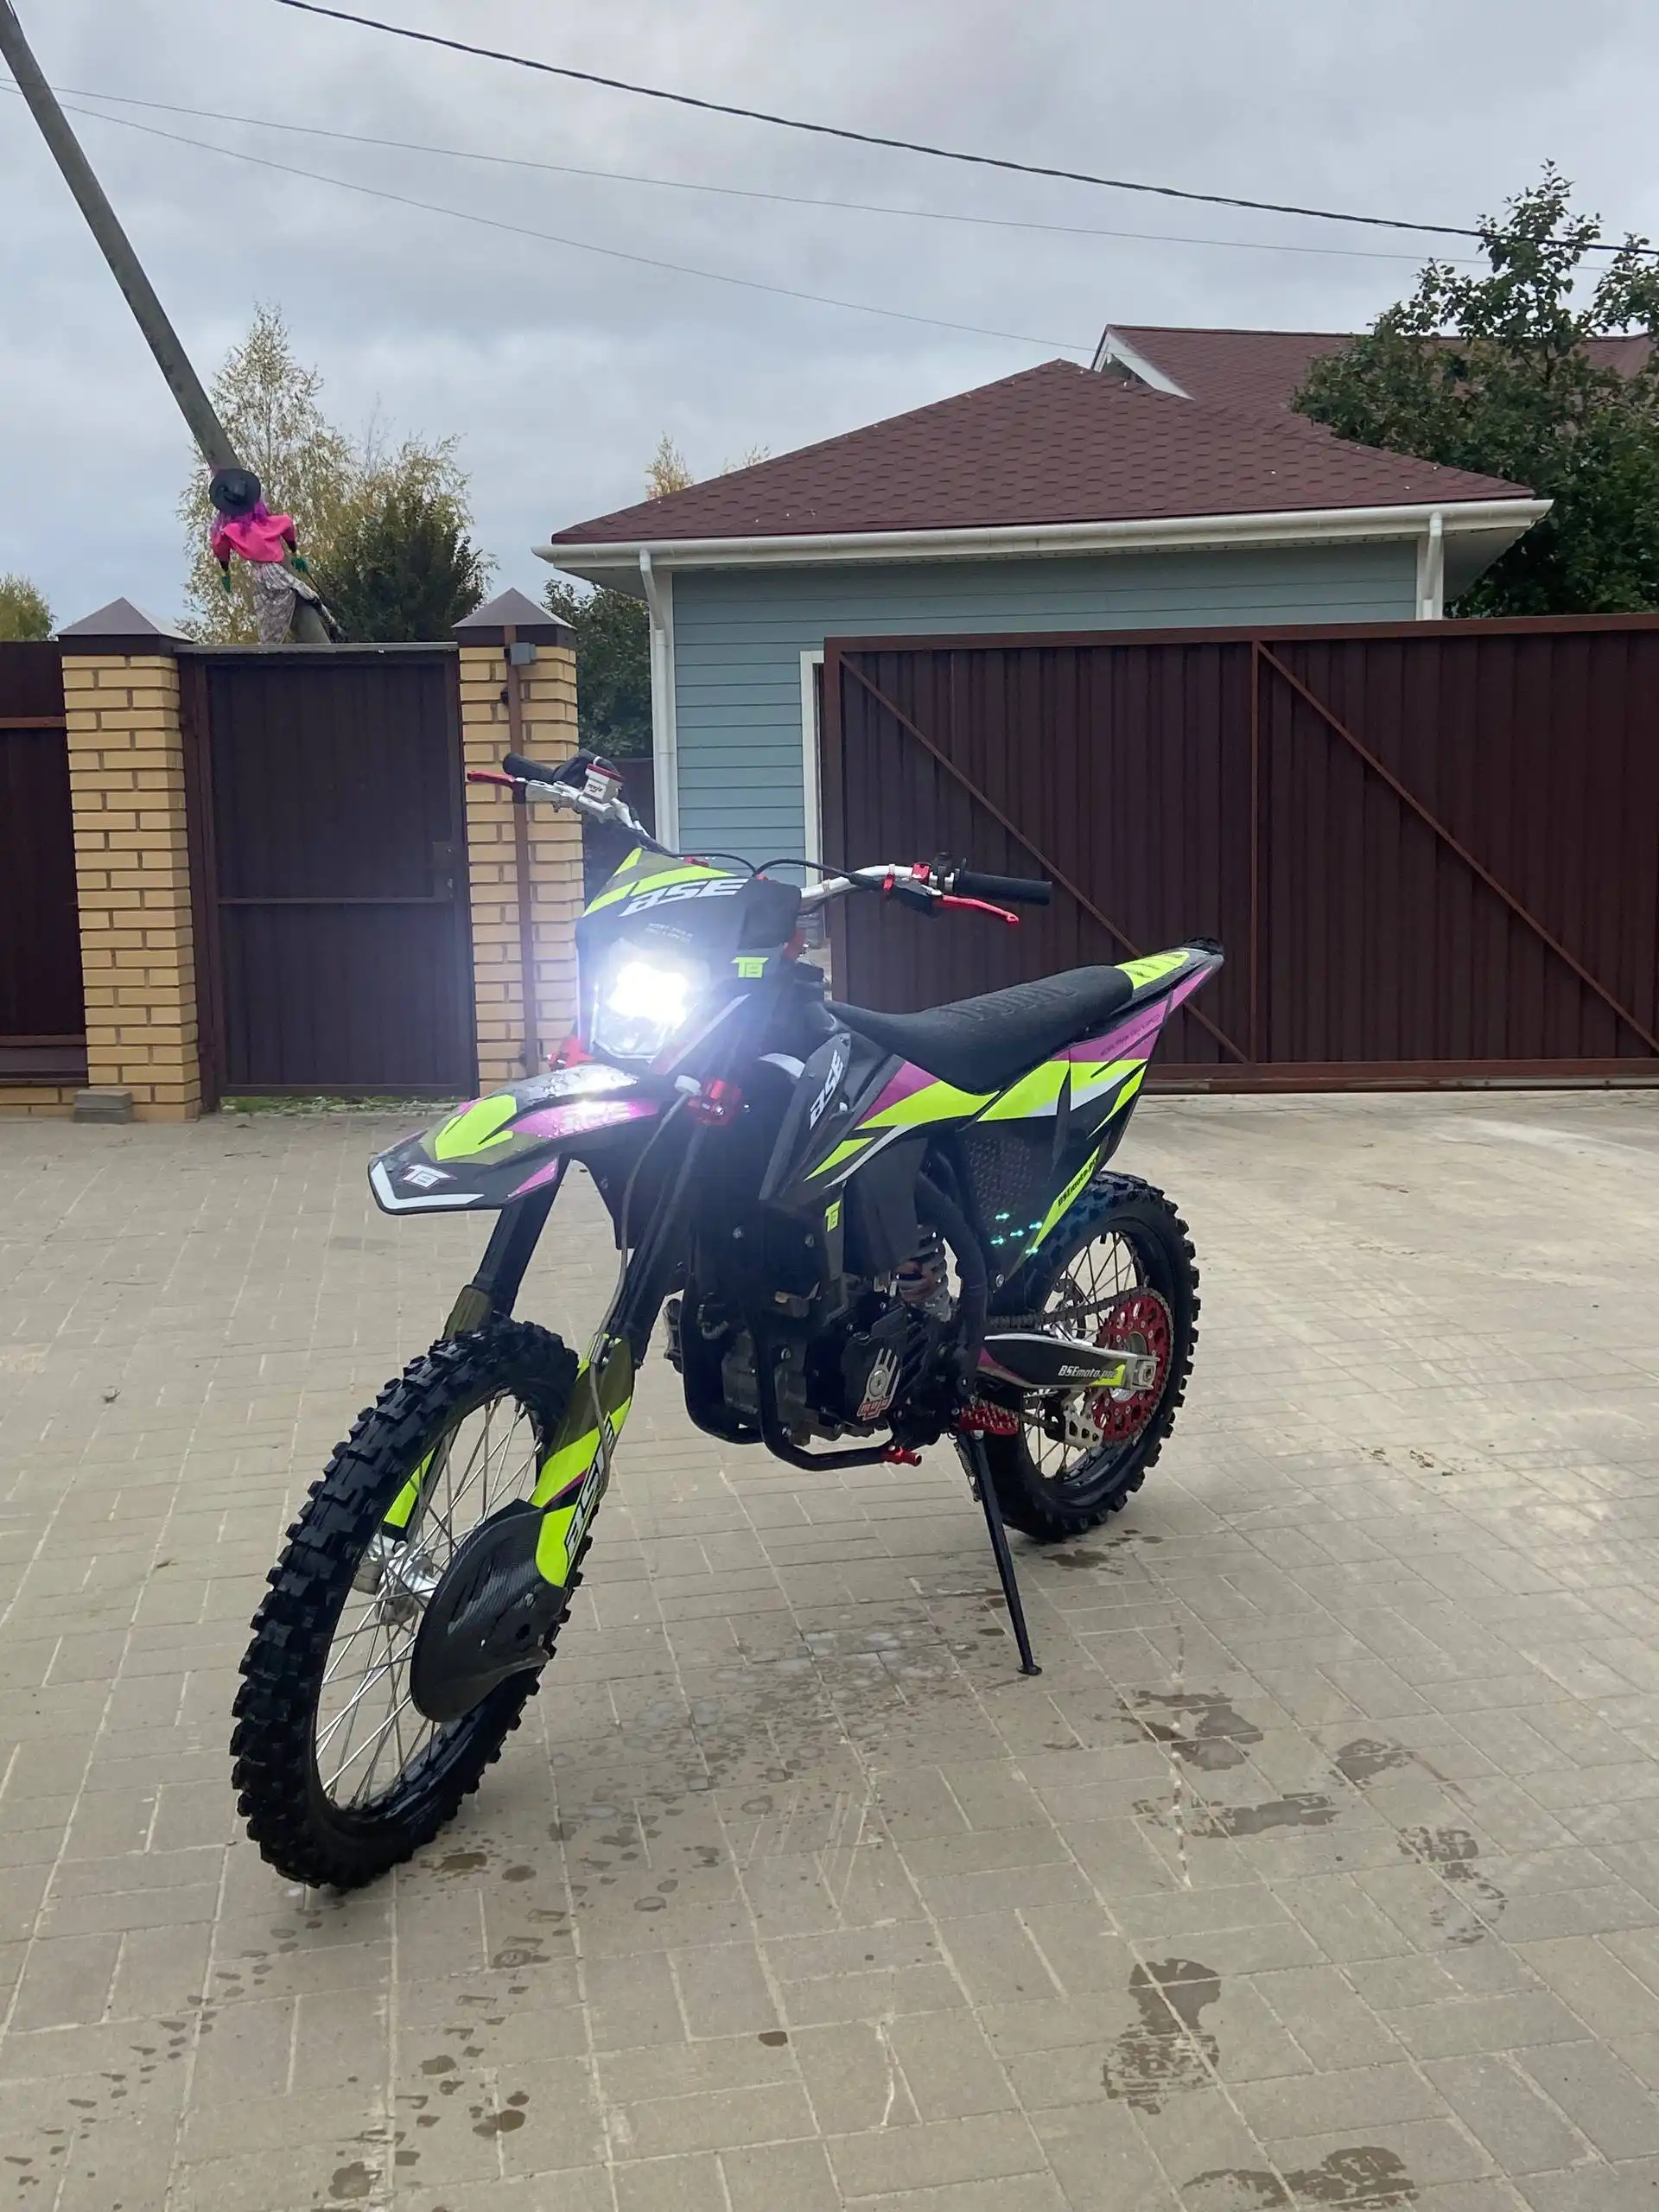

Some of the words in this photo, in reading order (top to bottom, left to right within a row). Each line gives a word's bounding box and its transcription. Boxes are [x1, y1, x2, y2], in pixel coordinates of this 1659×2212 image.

[618, 878, 750, 917] BSE
[810, 1050, 843, 1130] BSE
[1058, 1365, 1118, 1380] BSEmoto.pro
